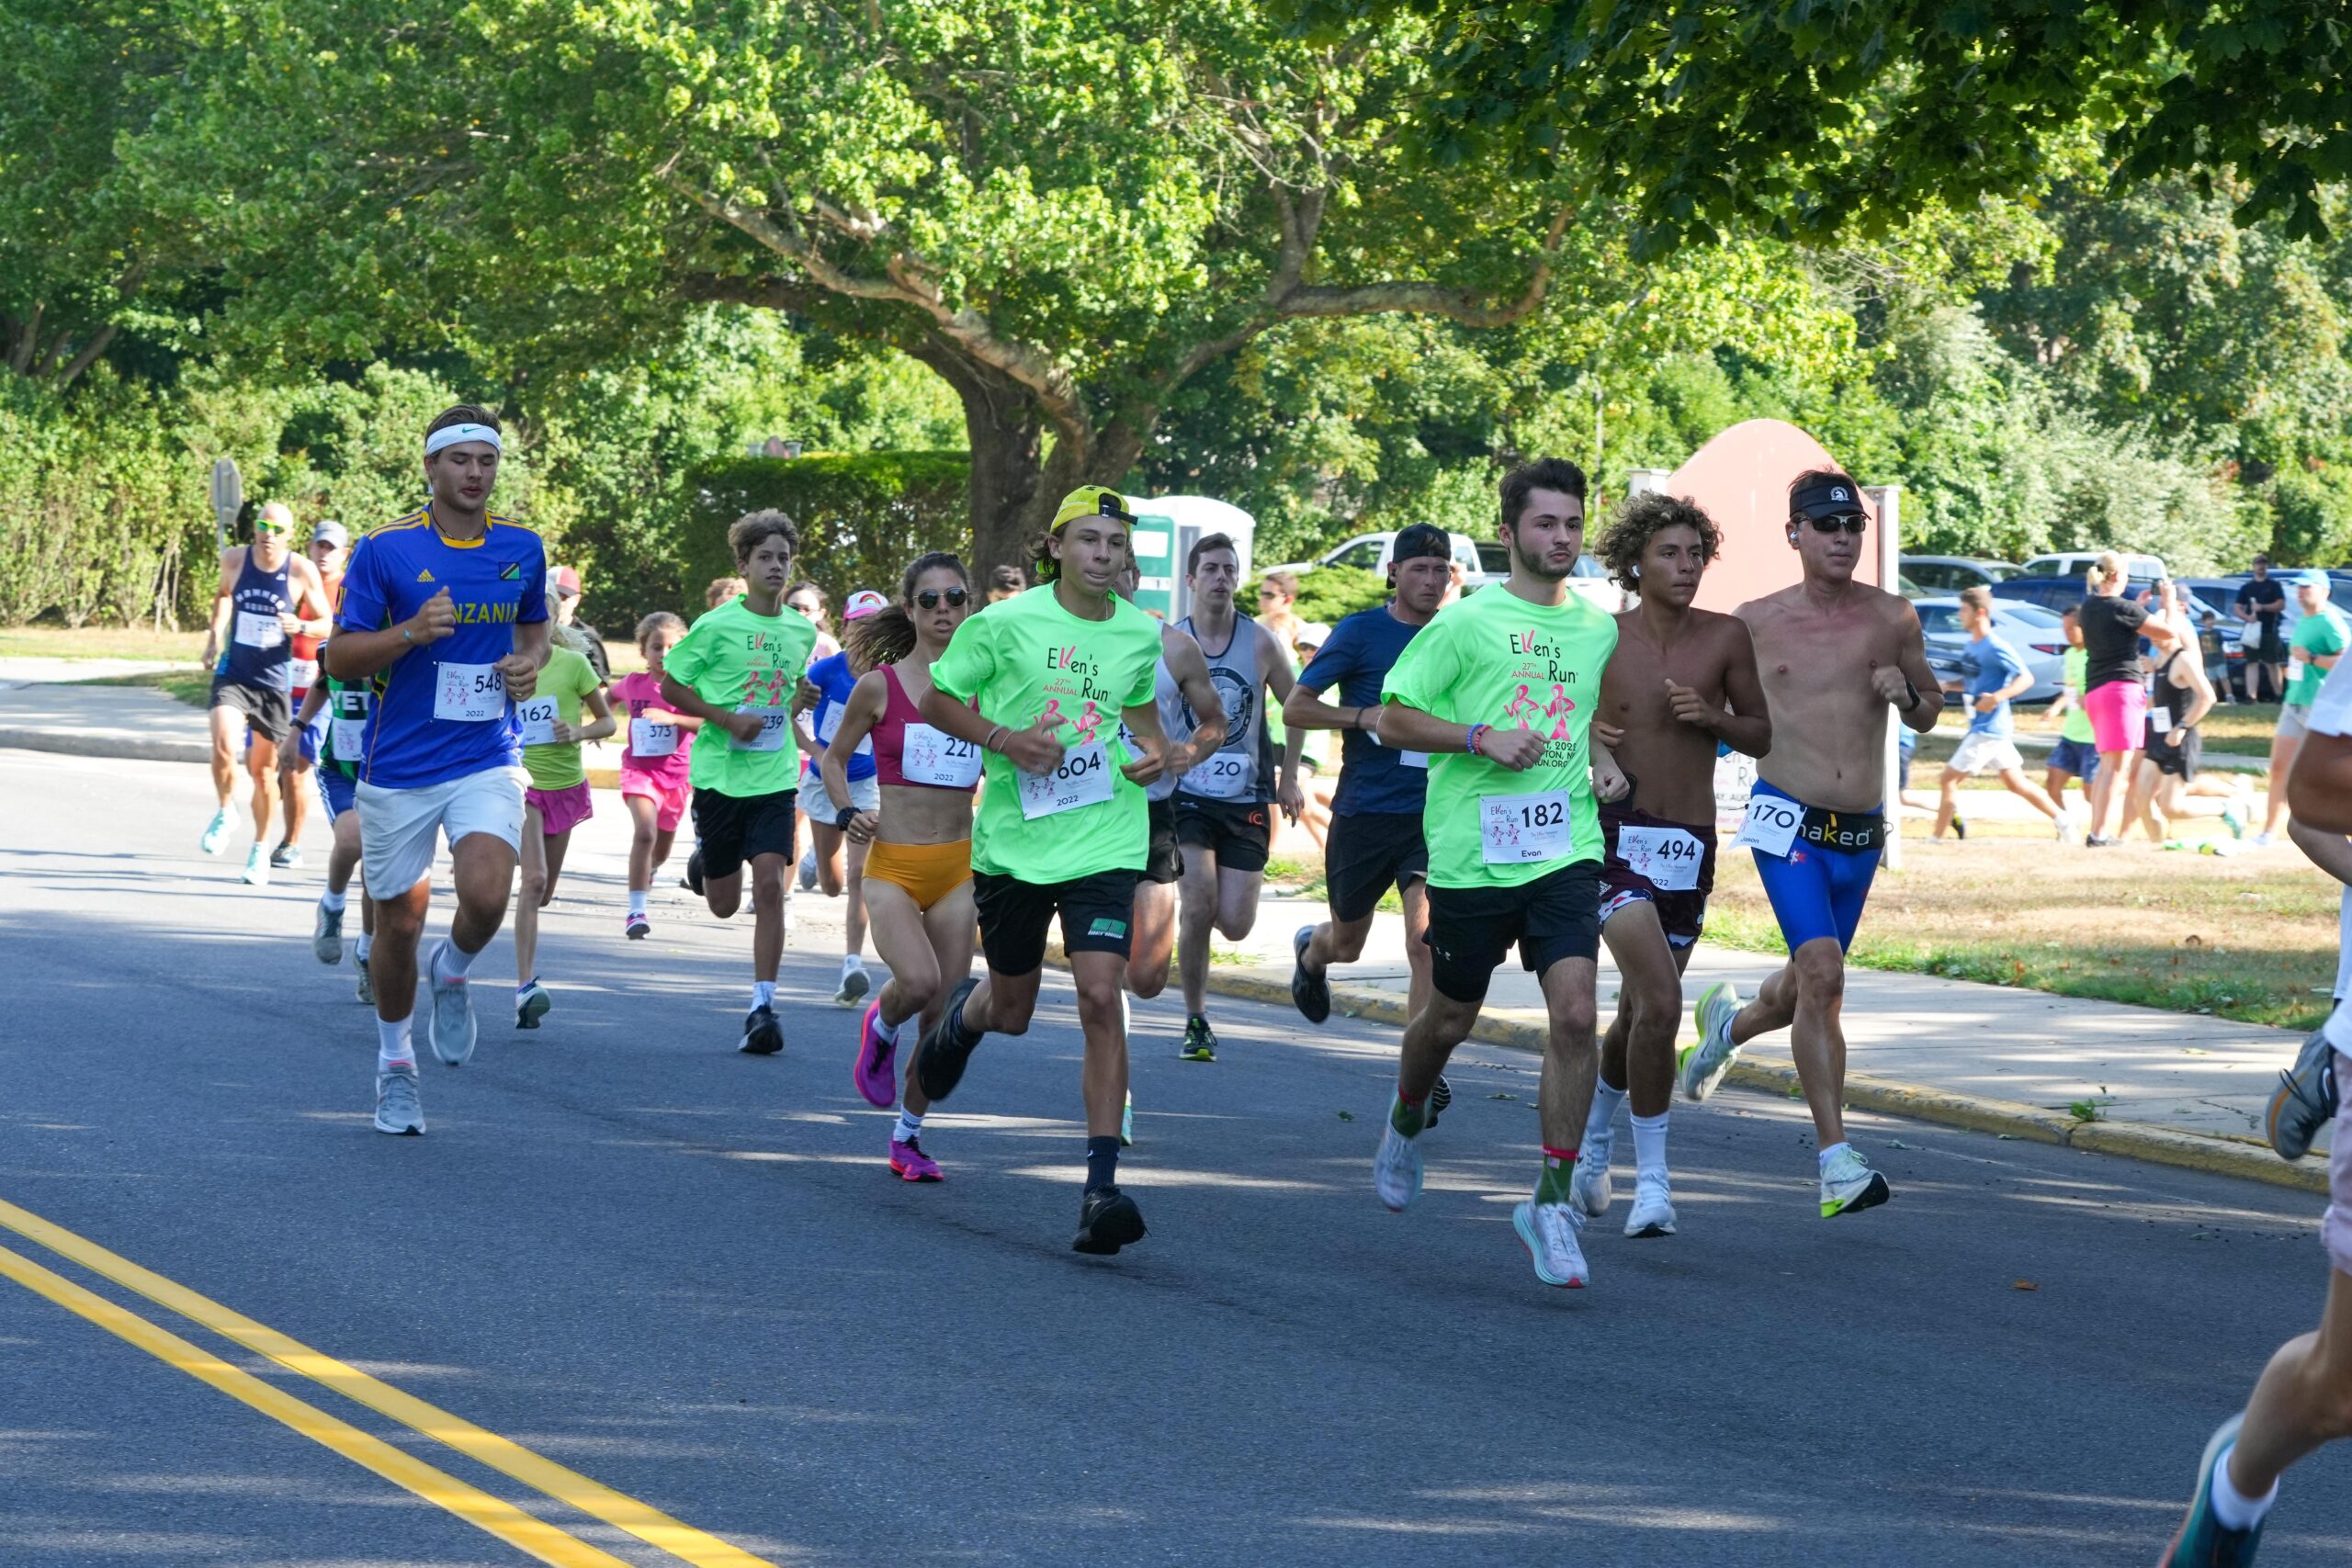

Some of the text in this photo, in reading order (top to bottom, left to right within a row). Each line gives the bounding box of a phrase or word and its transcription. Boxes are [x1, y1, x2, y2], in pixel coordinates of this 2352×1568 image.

[773, 653, 790, 670] Run
[1511, 671, 1545, 680] ANNUAL
[1548, 660, 1576, 683] Run
[474, 672, 502, 693] 548
[1043, 684, 1079, 695] ANNUAL
[1081, 677, 1108, 702] Run
[521, 705, 552, 722] 162
[650, 725, 672, 738] 373
[944, 737, 974, 758] 221
[1057, 751, 1101, 779] 604
[1213, 761, 1240, 776] 20
[934, 773, 954, 781] 2022
[1057, 795, 1079, 807] 2022
[1521, 802, 1564, 828] 182
[1753, 804, 1795, 829] 170
[1521, 850, 1542, 858] Evan
[1657, 840, 1695, 861] 494
[1650, 878, 1668, 886] 022
